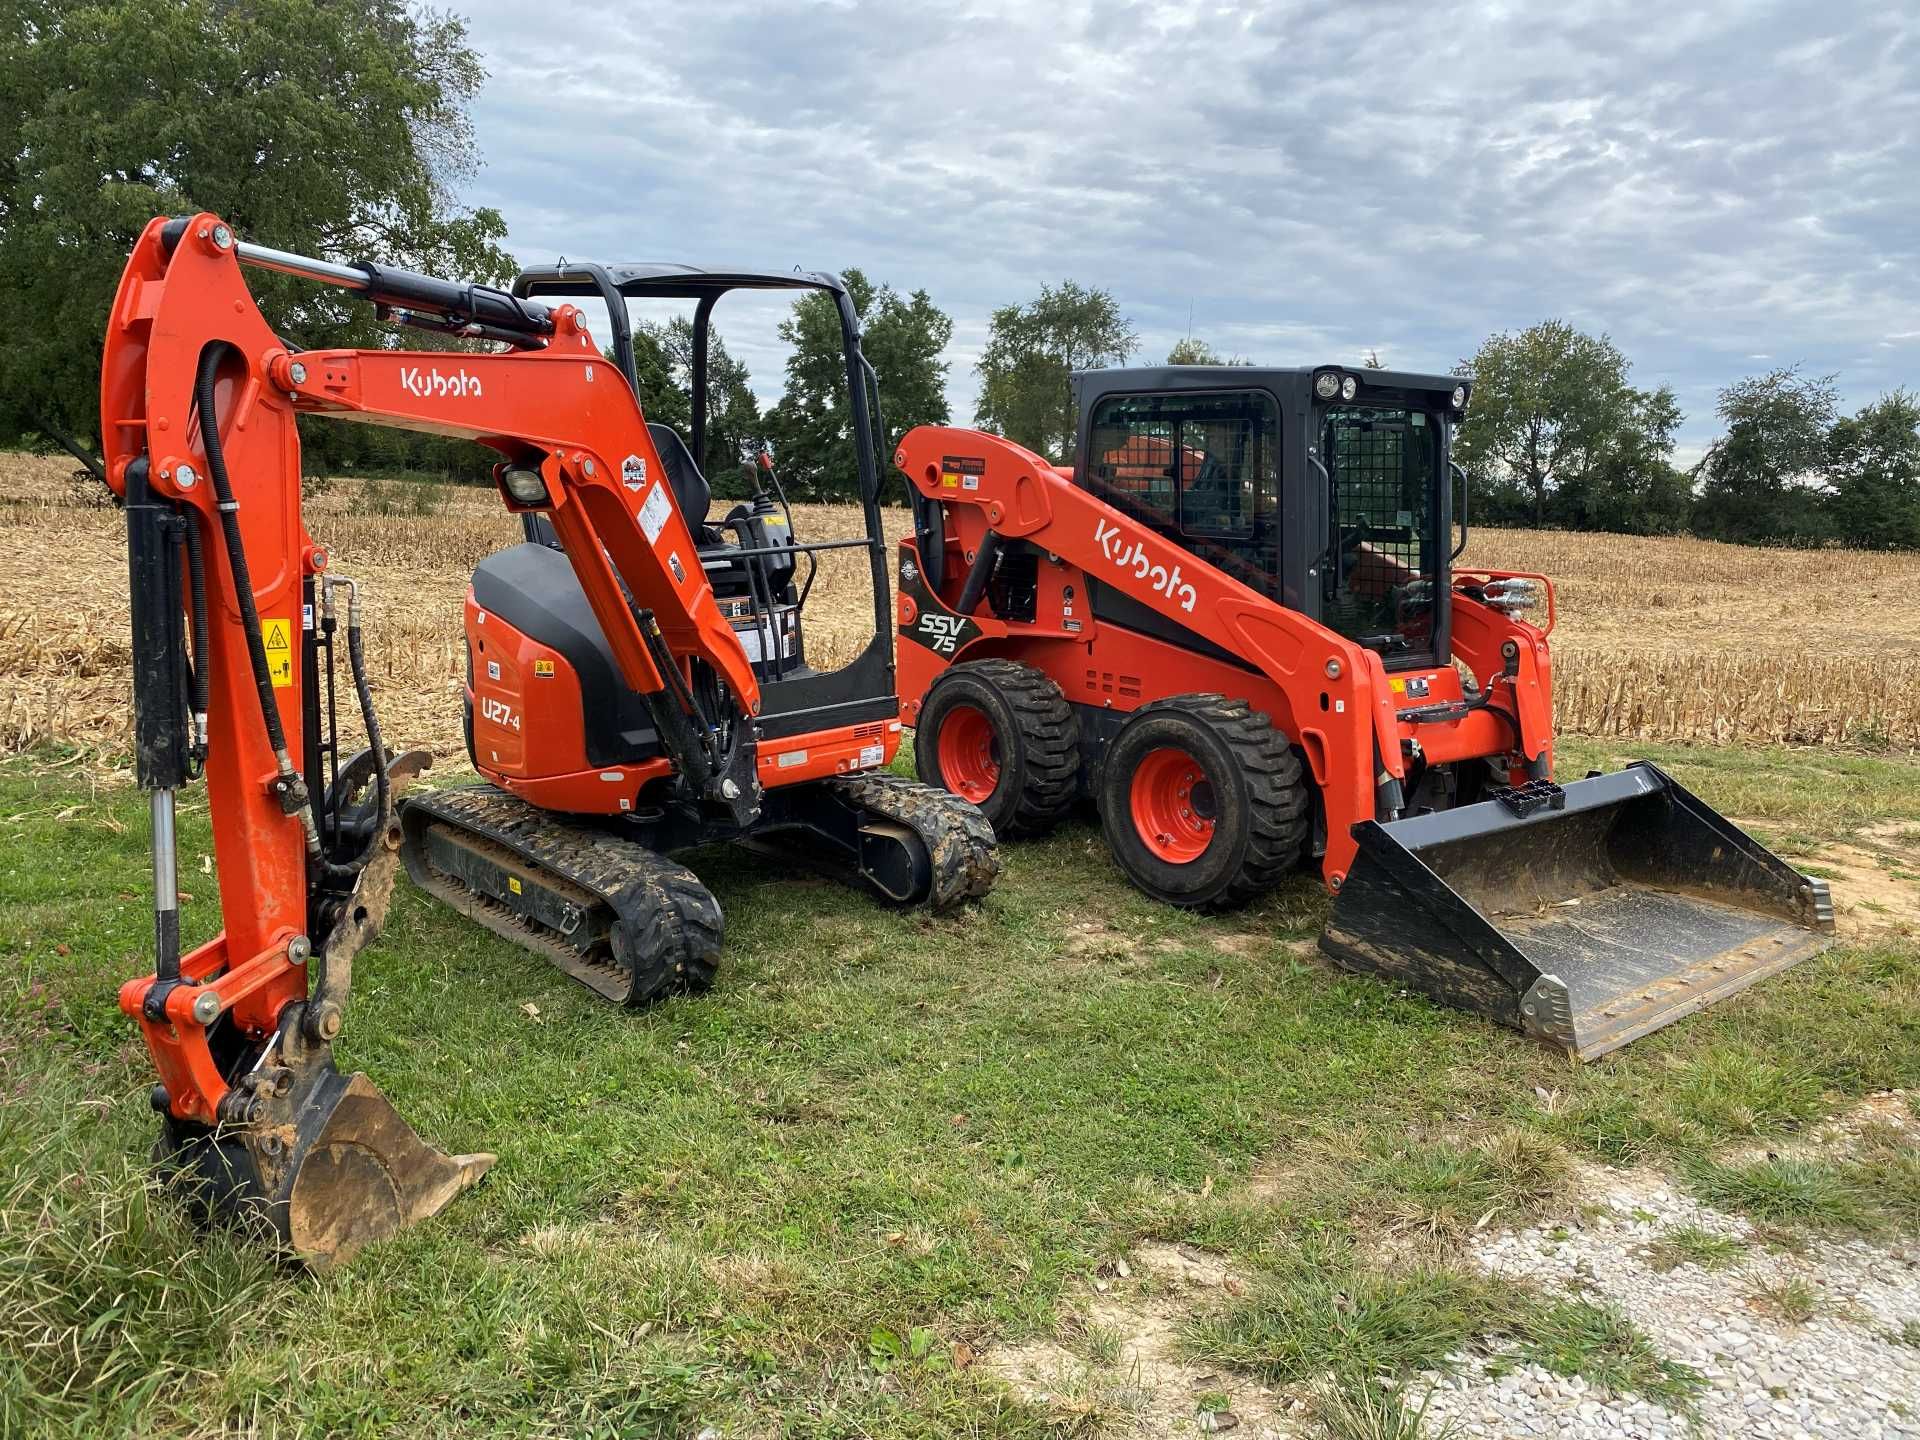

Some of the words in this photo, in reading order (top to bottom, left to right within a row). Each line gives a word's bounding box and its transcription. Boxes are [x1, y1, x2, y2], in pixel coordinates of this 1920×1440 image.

[400, 367, 482, 397] Kubota
[1094, 518, 1197, 613] Kubota
[918, 613, 967, 636] SSV
[932, 634, 957, 652] 75
[482, 696, 521, 731] U27-4
